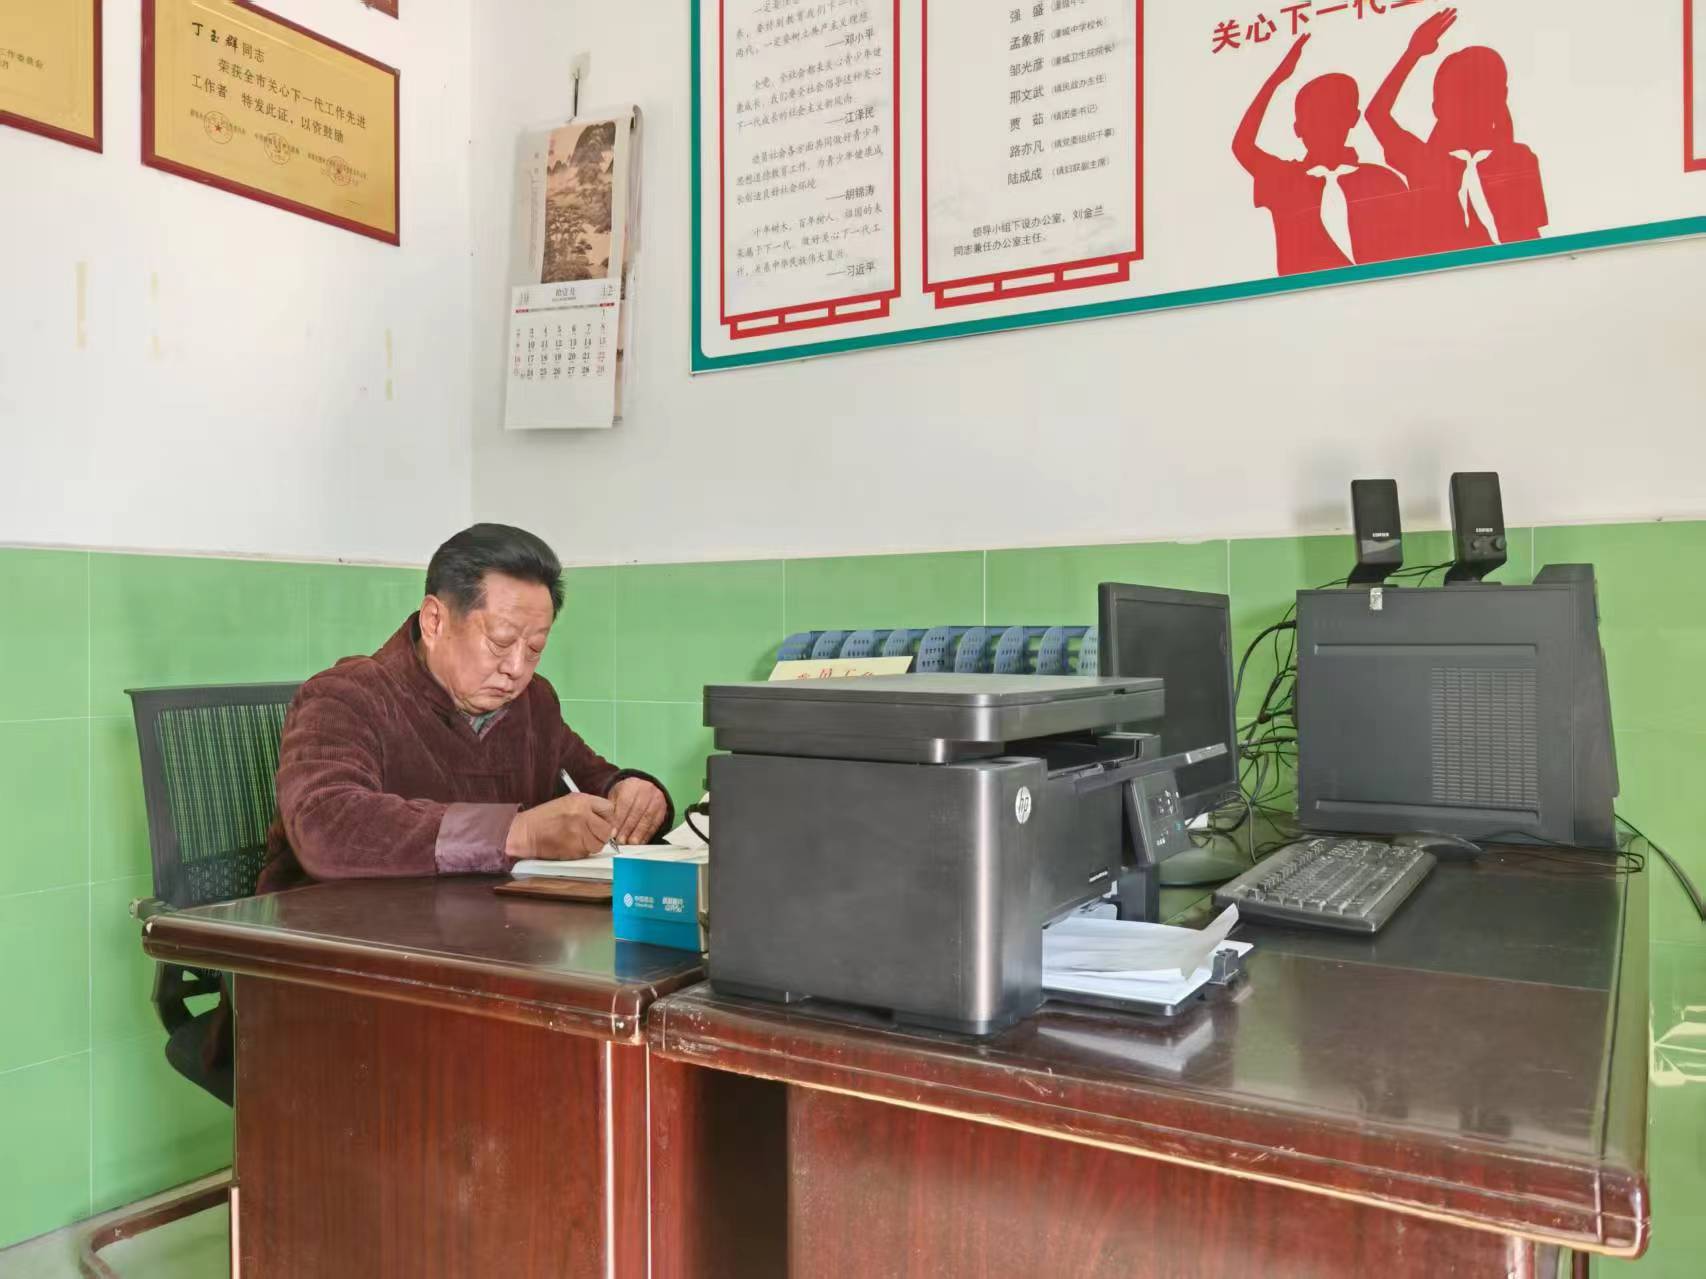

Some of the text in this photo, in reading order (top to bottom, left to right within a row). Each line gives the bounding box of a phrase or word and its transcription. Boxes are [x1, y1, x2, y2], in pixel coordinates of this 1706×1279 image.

[1212, 0, 1425, 54] 关心下一代
